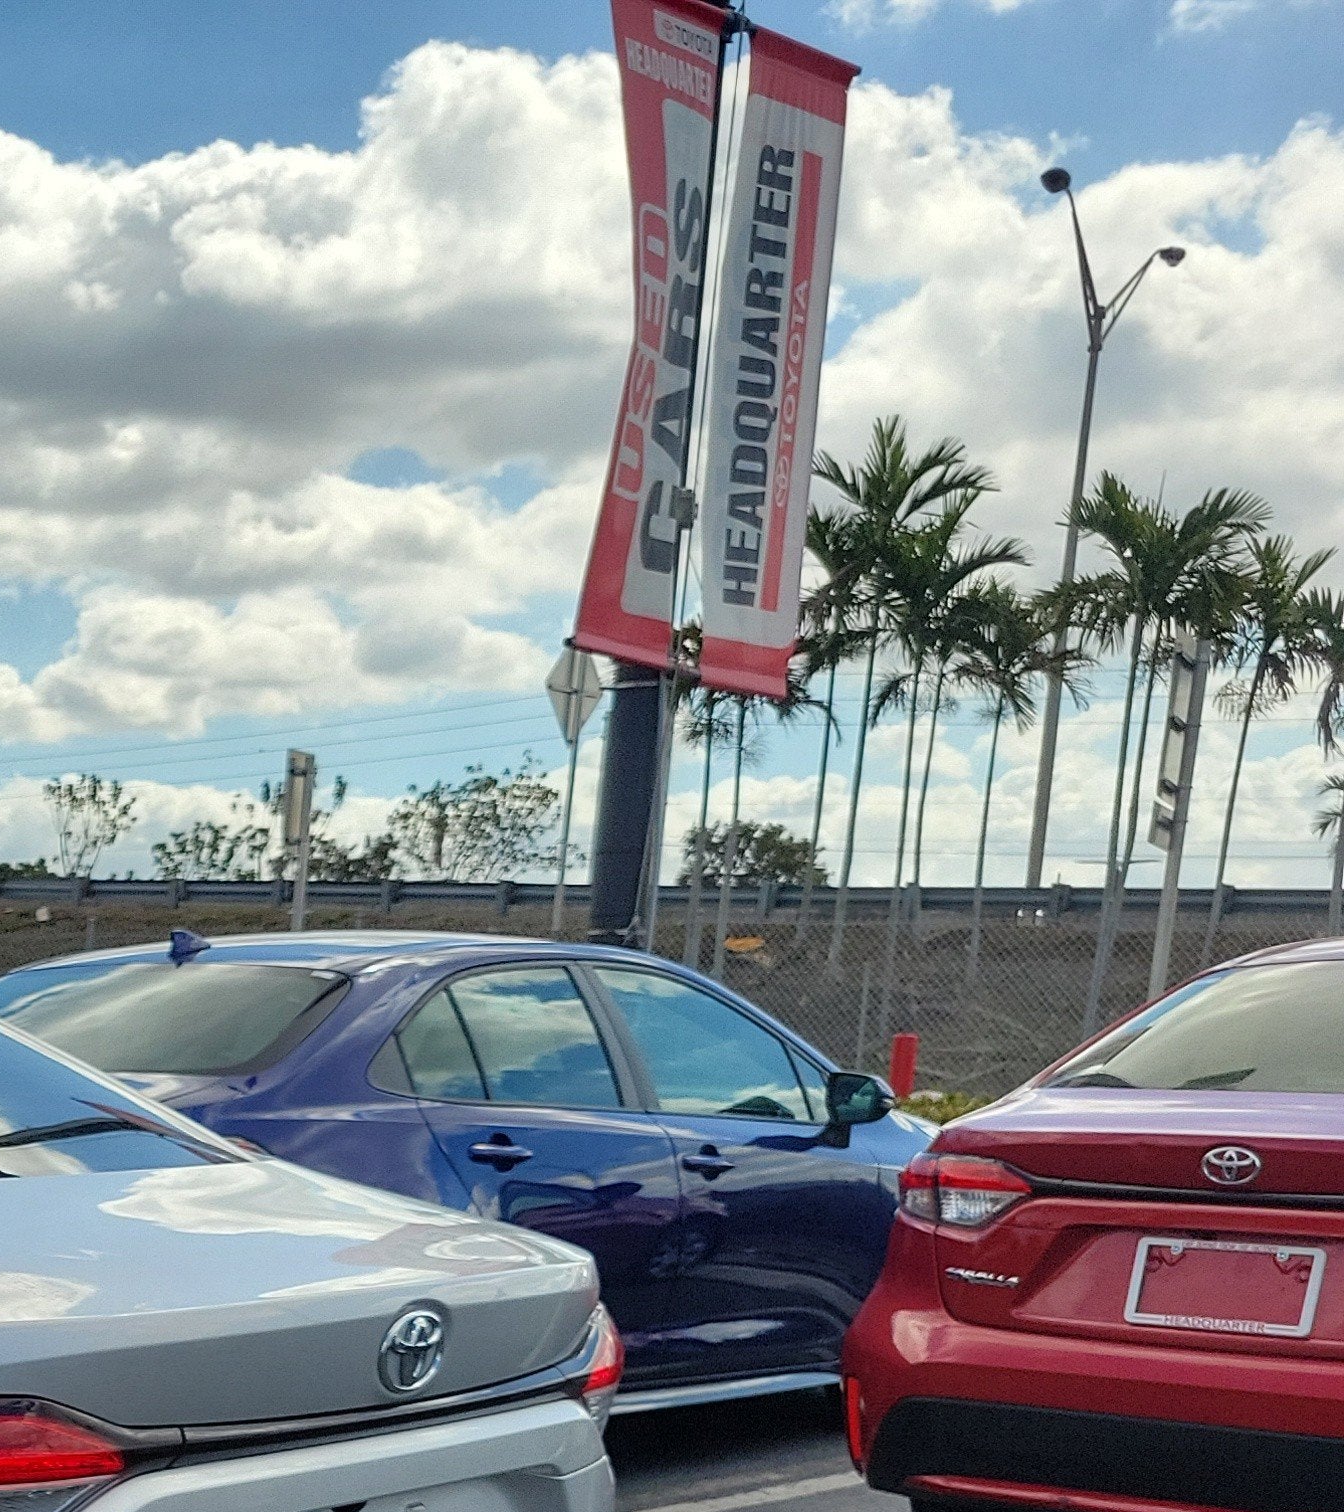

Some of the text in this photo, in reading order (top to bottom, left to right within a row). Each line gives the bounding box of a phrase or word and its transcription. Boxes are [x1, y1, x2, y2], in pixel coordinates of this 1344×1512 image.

[615, 206, 670, 497] USED
[640, 178, 703, 574] CARS
[722, 144, 795, 607] HEADQUARTER
[782, 280, 809, 442] TOYOTA
[1163, 1314, 1266, 1333] HEADQUARTER
